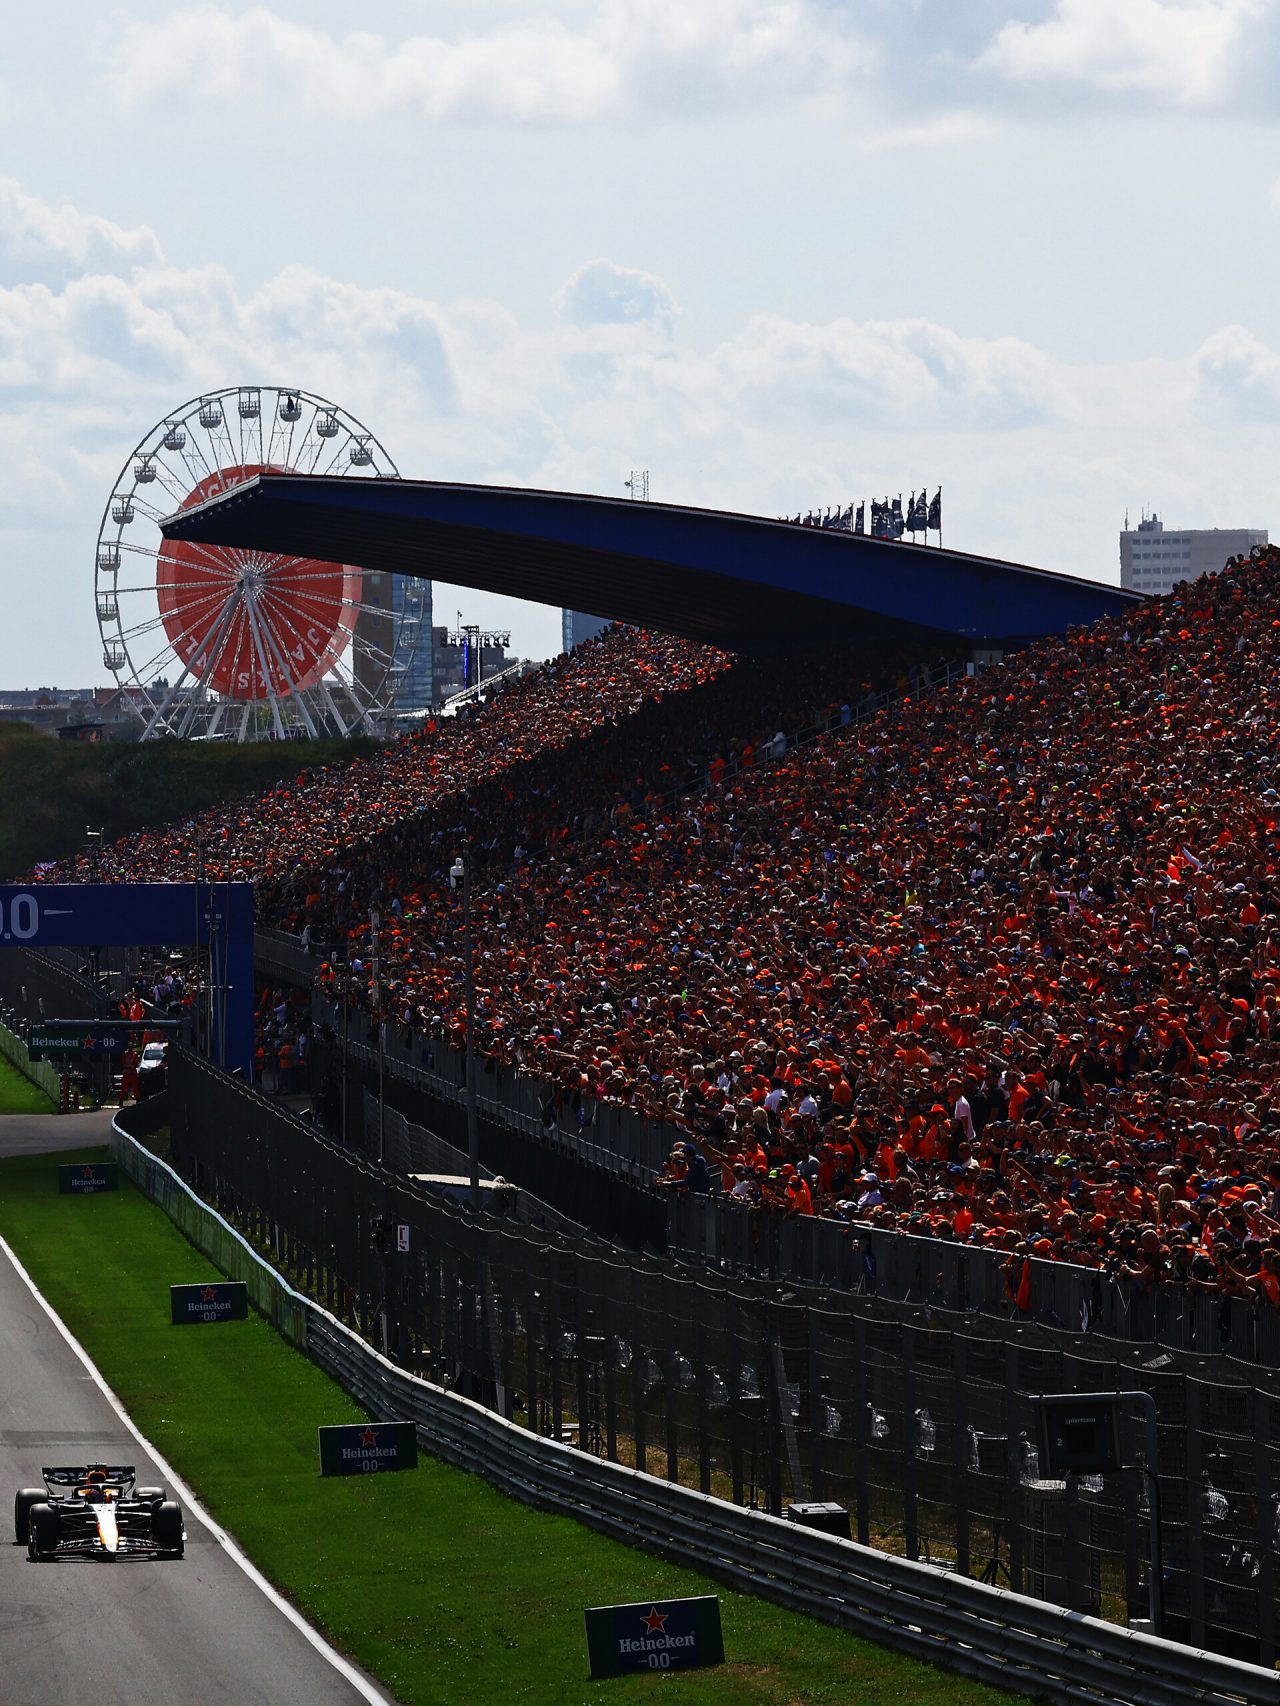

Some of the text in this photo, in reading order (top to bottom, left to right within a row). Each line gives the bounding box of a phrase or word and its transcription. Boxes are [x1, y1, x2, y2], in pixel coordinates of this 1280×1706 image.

[31, 1036, 80, 1048] Heineken
[188, 1301, 232, 1312] Heineken
[342, 1446, 398, 1460] Heineken
[618, 1633, 696, 1653] Heineken
